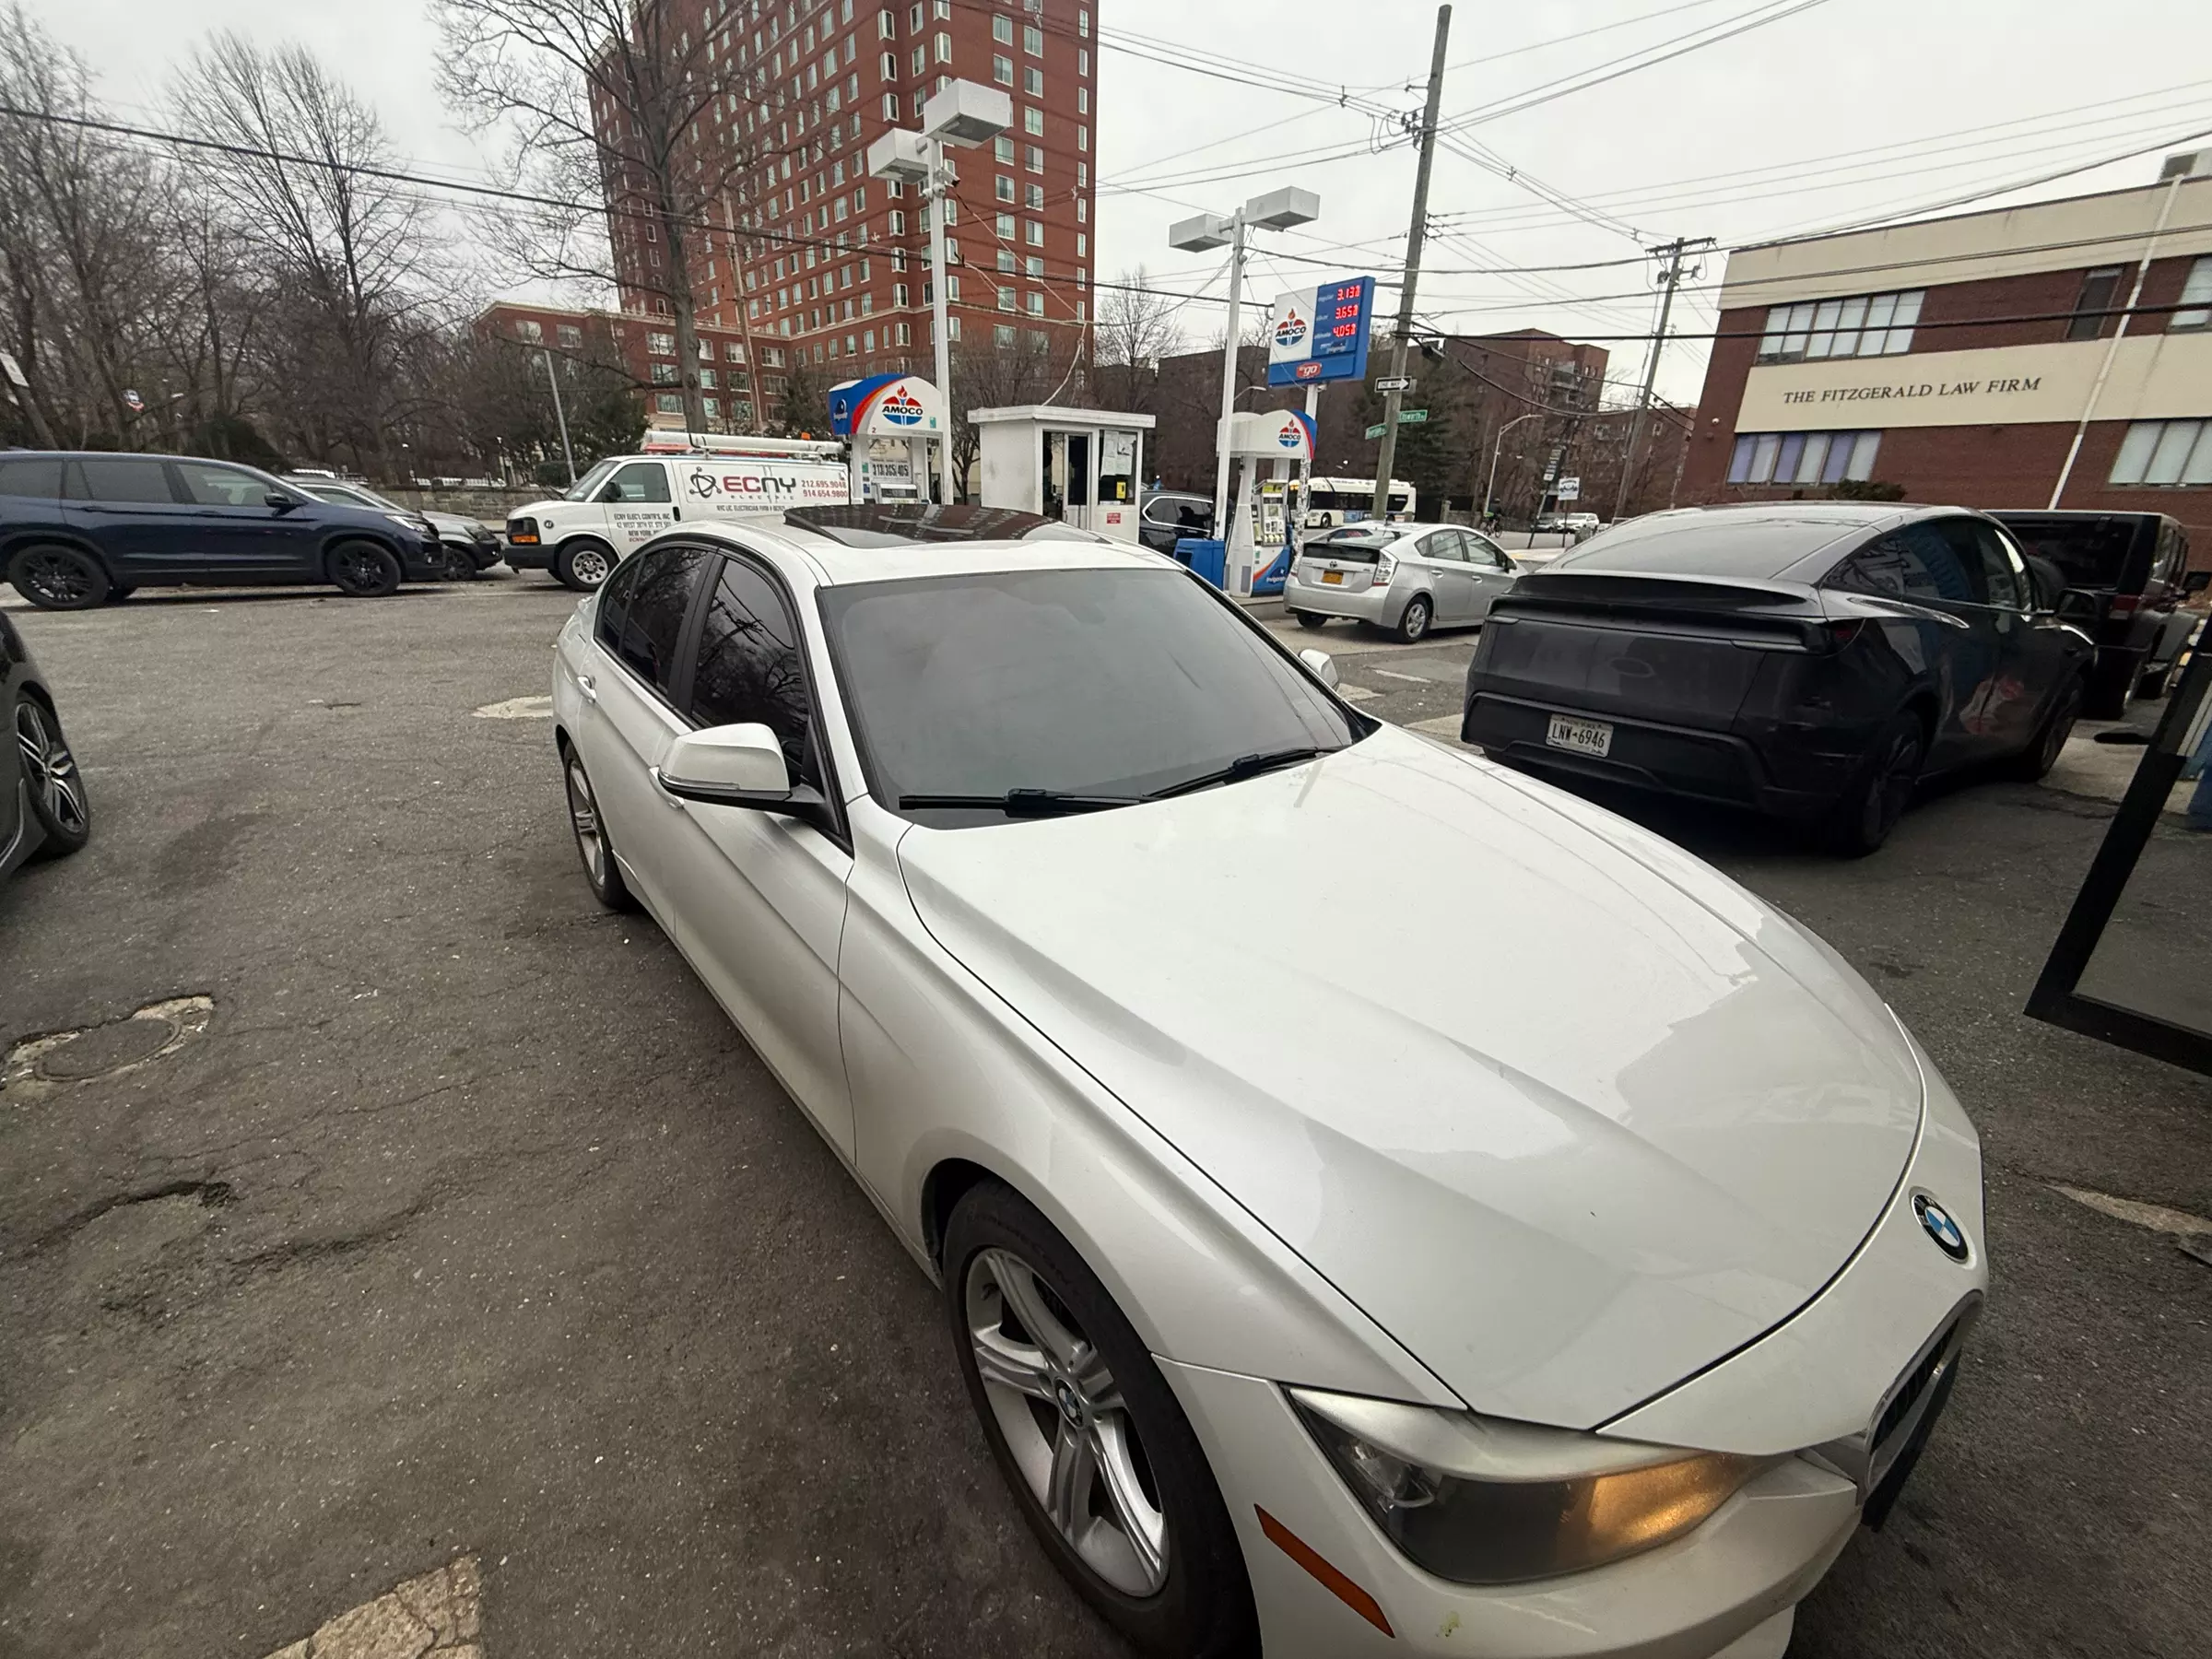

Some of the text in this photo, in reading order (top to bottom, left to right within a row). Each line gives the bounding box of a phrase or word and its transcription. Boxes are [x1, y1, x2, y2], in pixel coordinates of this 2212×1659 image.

[1275, 326, 1307, 337] AMOCO
[1783, 377, 2042, 404] THE FITZGERALD LAW FIRM
[882, 406, 924, 416] AMOCO
[723, 476, 796, 493] ECNY
[801, 479, 847, 488] 212.695.9048
[803, 489, 848, 498] 914.654.9800
